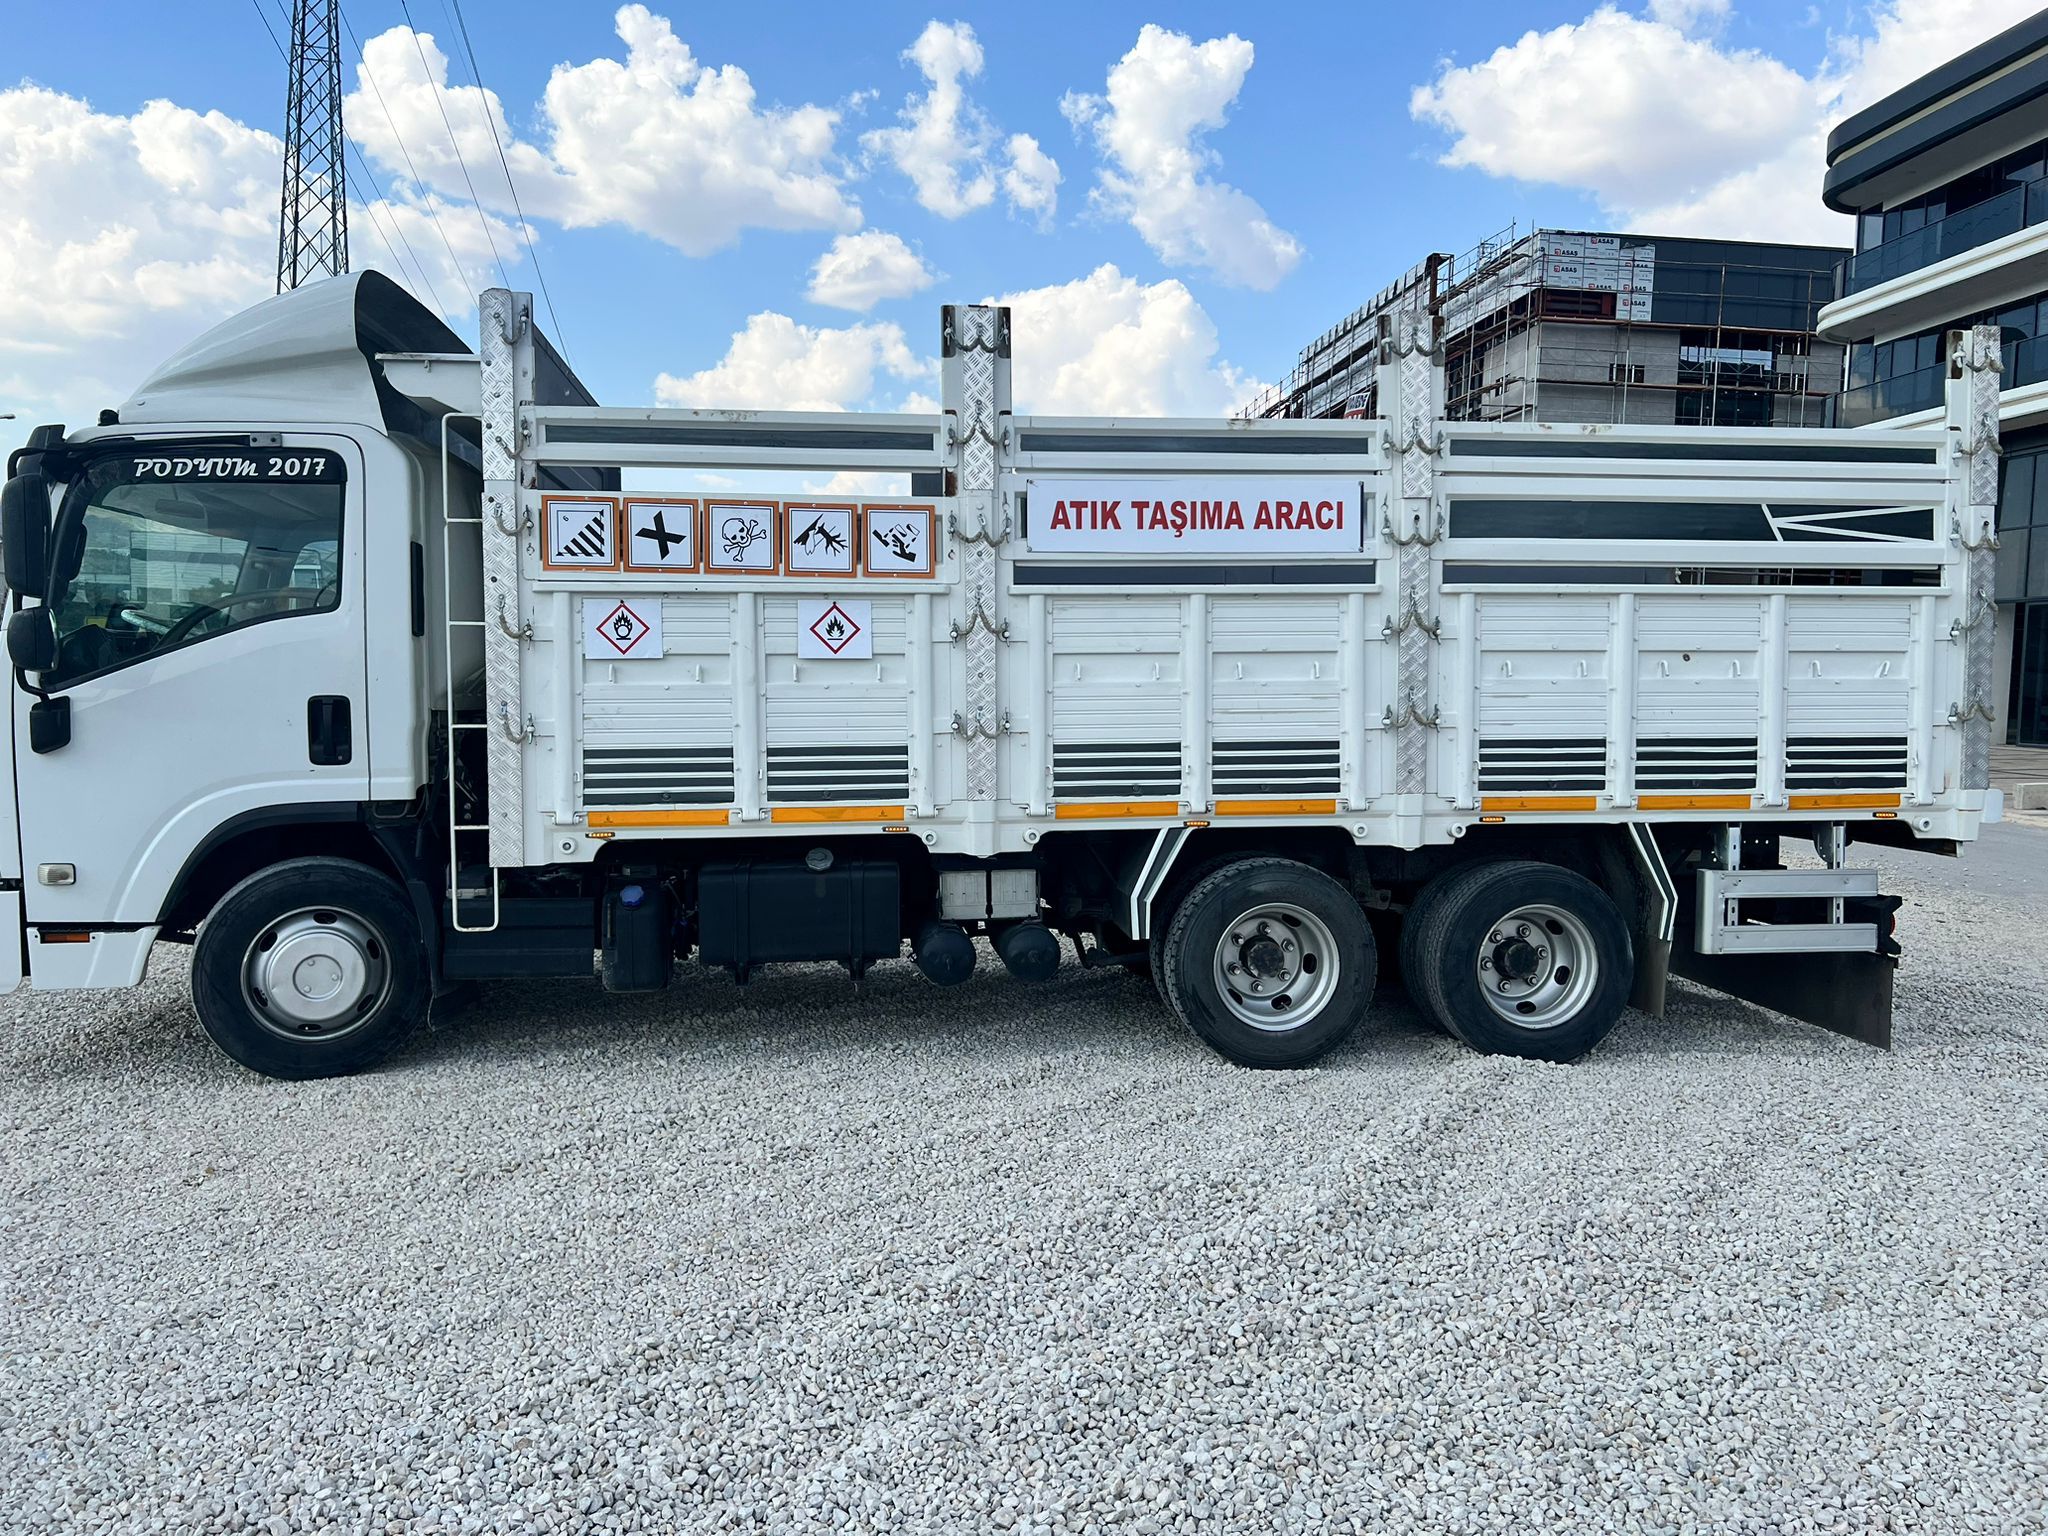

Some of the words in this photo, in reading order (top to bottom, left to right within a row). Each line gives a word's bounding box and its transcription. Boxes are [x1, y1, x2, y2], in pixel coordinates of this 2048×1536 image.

[133, 457, 259, 477] PODYUM
[268, 457, 326, 476] 2017
[1050, 500, 1122, 530] ATIK
[1131, 500, 1245, 538] TAŞIMA
[1253, 500, 1344, 530] ARACI
